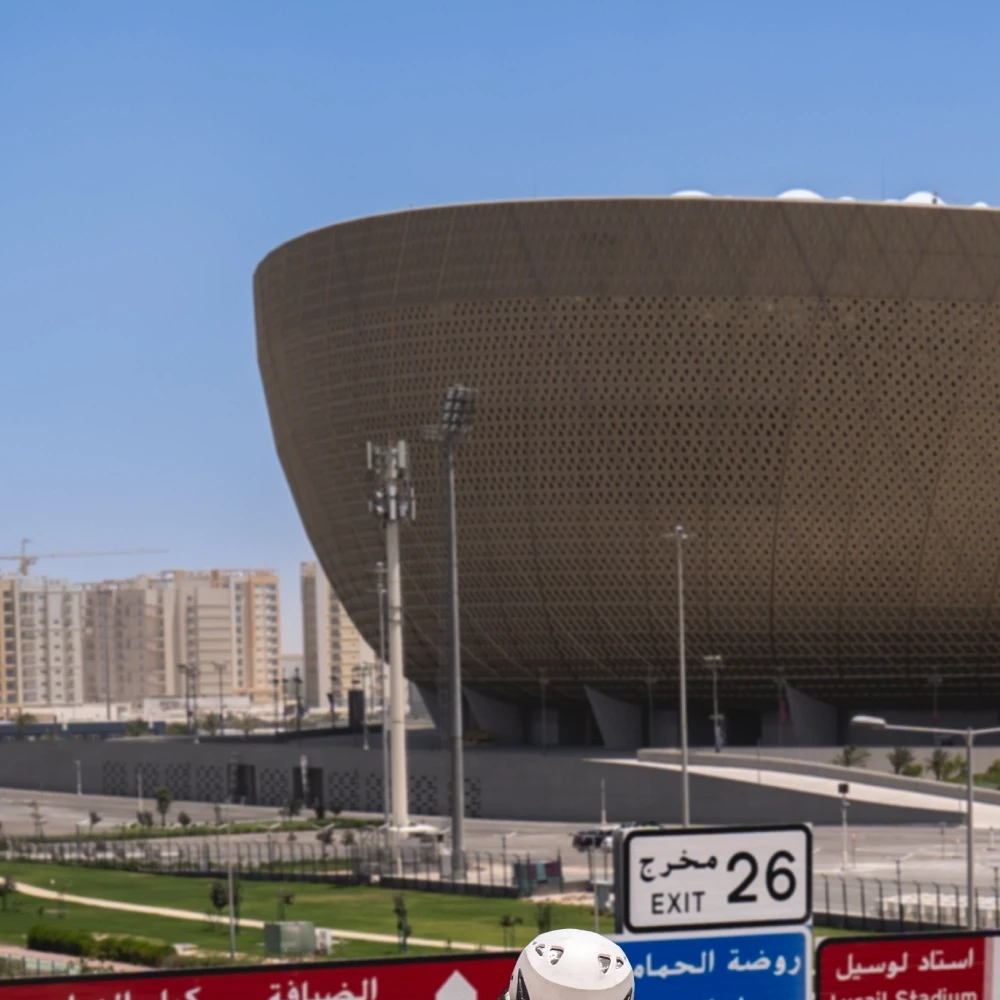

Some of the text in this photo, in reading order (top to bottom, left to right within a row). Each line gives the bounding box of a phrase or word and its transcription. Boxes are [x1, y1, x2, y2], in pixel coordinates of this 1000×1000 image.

[639, 849, 718, 882] مخرج
[727, 849, 797, 904] 26
[651, 891, 706, 915] EXIT
[634, 949, 801, 979] روضة الحمام
[835, 948, 974, 981] استاد لوسيل
